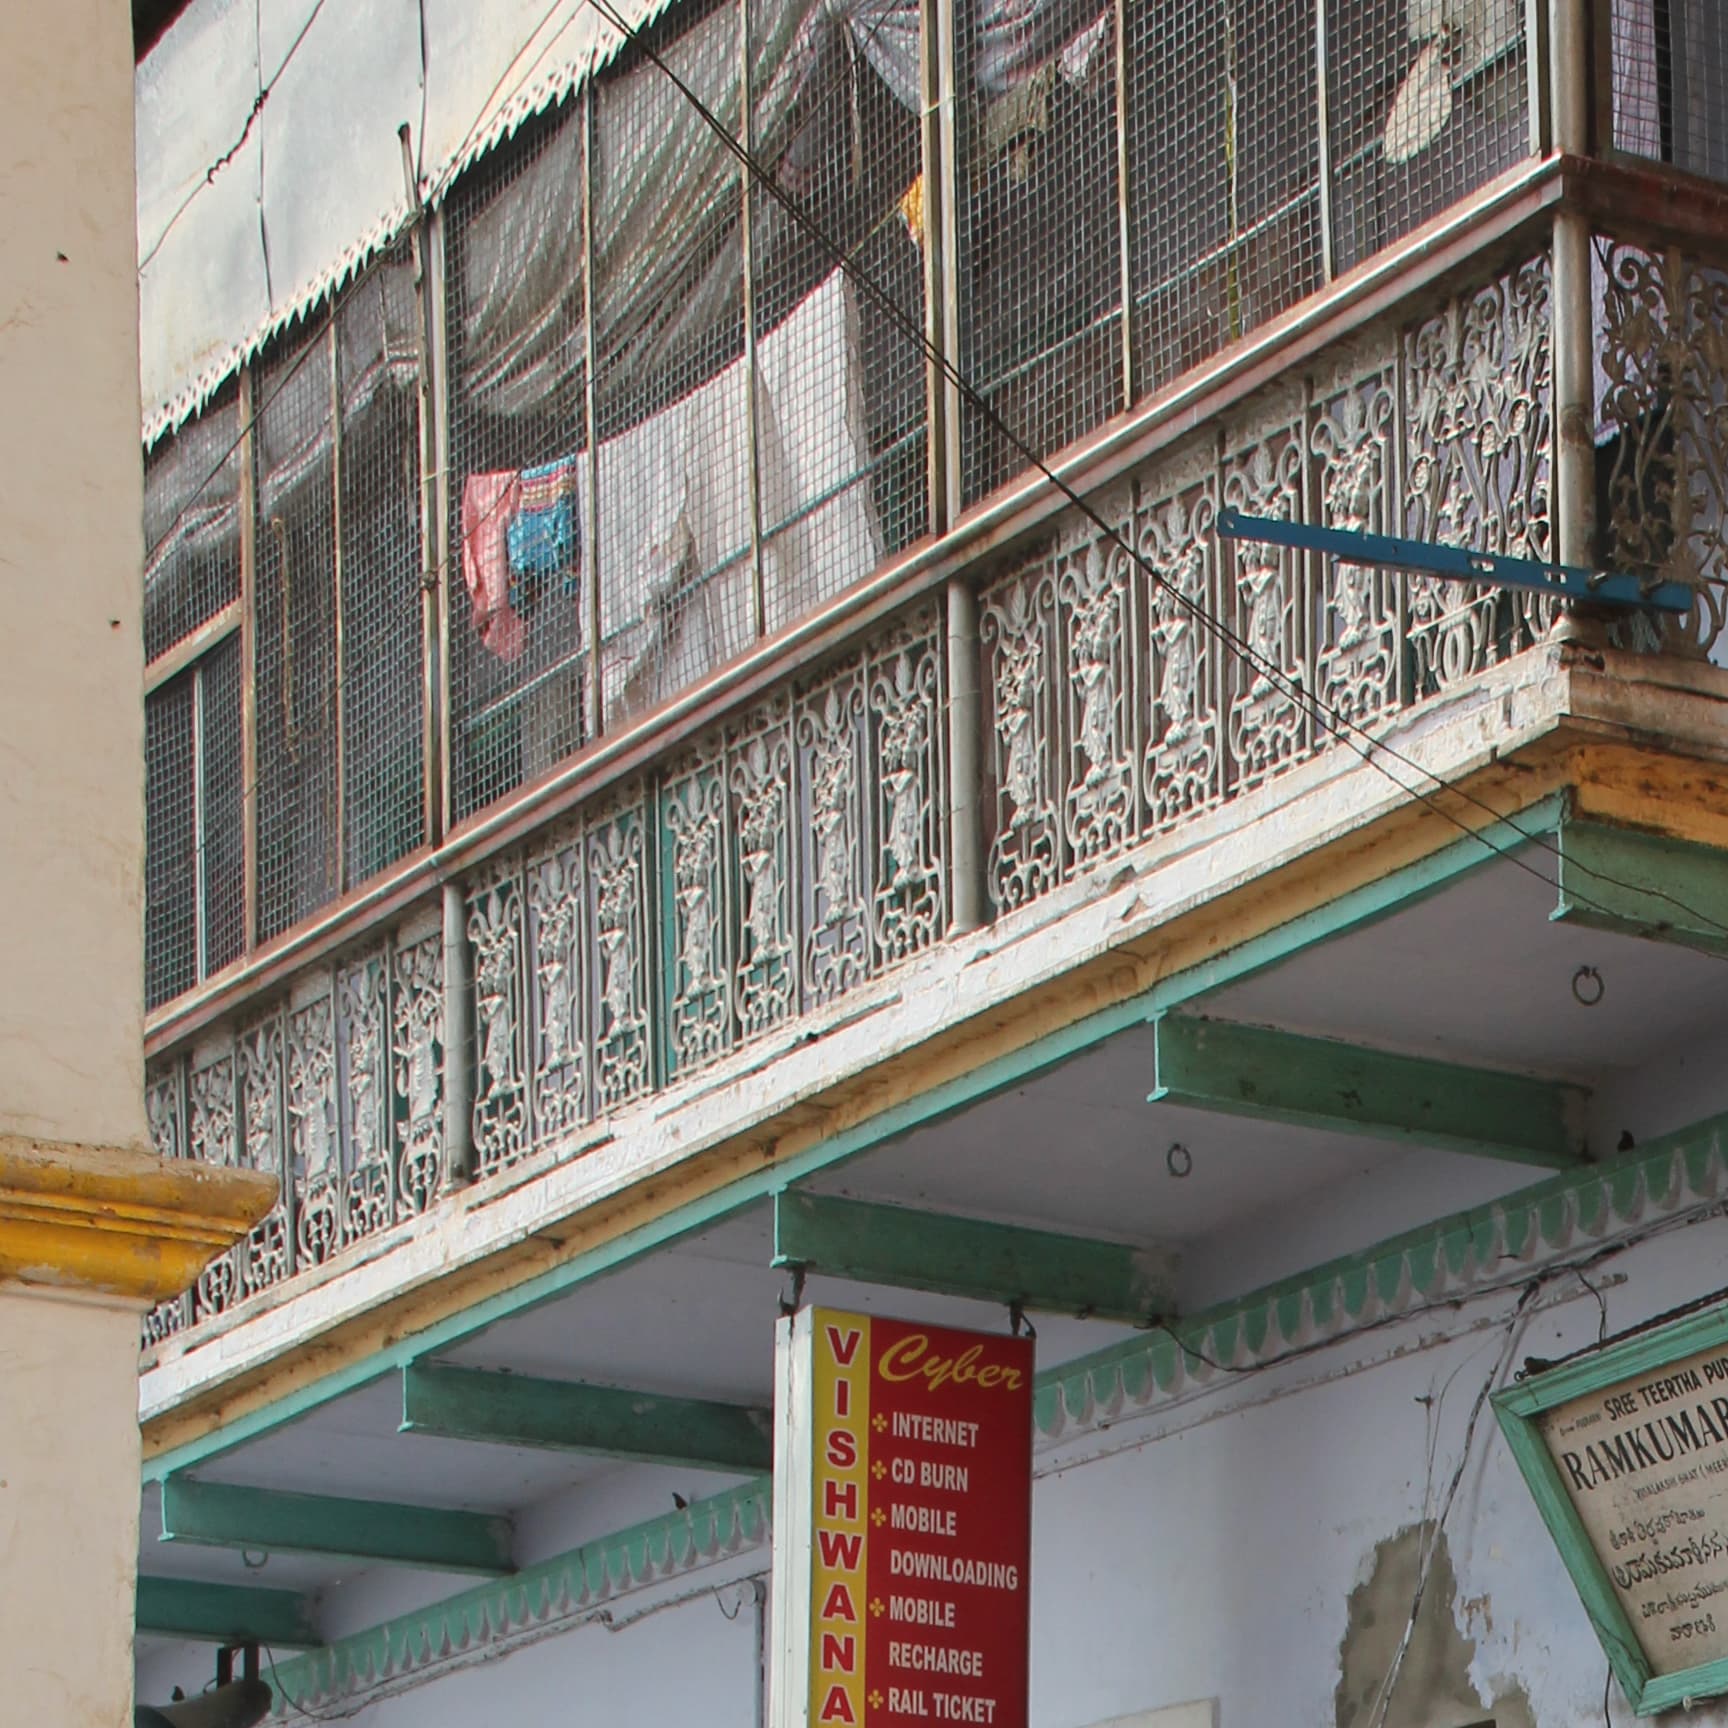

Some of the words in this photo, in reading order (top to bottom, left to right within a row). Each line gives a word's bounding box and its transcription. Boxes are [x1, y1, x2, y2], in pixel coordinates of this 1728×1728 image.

[878, 1334, 1024, 1391] Cyber
[1603, 1391, 1639, 1422] SREE
[1637, 1370, 1701, 1408] TEERTHA
[892, 1411, 979, 1448] INTERNET
[891, 1458, 916, 1485] CD
[920, 1462, 969, 1492] BURN
[891, 1503, 957, 1536] MOBILE
[890, 1549, 1018, 1590] DOWNLOADING
[889, 1595, 956, 1628] MOBILE
[889, 1641, 984, 1677] RECHARGE
[888, 1686, 928, 1717] RAIL
[933, 1692, 996, 1724] TICKET
